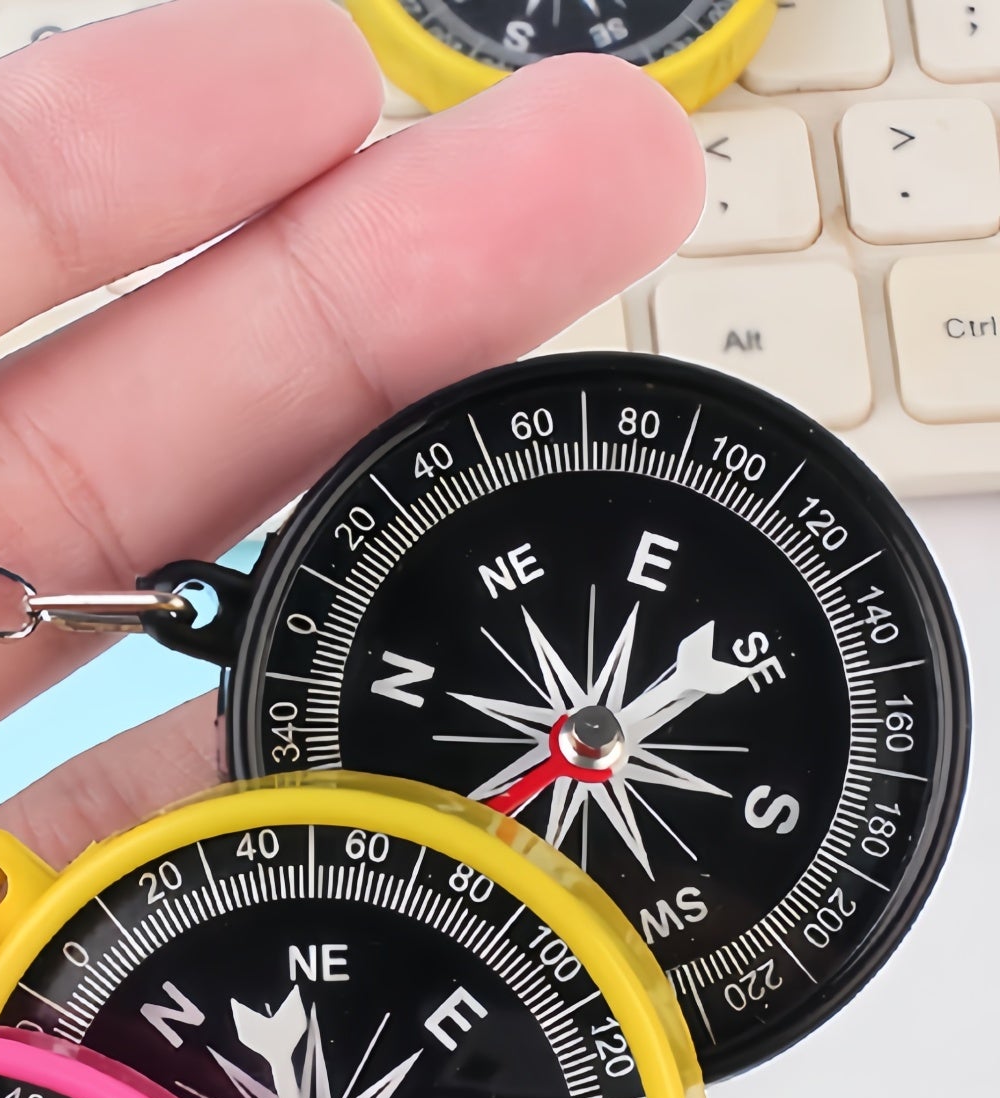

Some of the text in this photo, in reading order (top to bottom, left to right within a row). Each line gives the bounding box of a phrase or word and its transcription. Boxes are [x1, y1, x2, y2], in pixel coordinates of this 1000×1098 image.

[503, 20, 535, 53] S
[724, 329, 763, 352] Alt
[944, 316, 998, 338] Ctrl
[511, 410, 555, 439] 60
[618, 410, 661, 439] 80
[413, 442, 455, 480] 40
[711, 437, 767, 482] 100
[334, 506, 376, 550] 20
[797, 496, 848, 552] 120
[477, 542, 546, 599] NE
[626, 530, 680, 592] E
[286, 613, 318, 634] 0
[860, 585, 900, 645] 140
[370, 650, 436, 707] N
[731, 630, 787, 695] SE
[269, 702, 300, 763] 340
[885, 698, 913, 753] 160
[743, 783, 800, 836] S
[861, 801, 901, 858] 180
[236, 832, 280, 861] 40
[345, 832, 390, 863] 60
[139, 861, 184, 905] 20
[448, 864, 494, 903] 80
[639, 885, 709, 944] SW
[804, 886, 857, 948] 200
[63, 942, 89, 967] 0
[289, 944, 349, 983] NE
[527, 923, 581, 983] 100
[723, 958, 783, 1013] 220
[140, 981, 206, 1049] N
[424, 985, 489, 1051] E
[590, 1016, 635, 1079] 120
